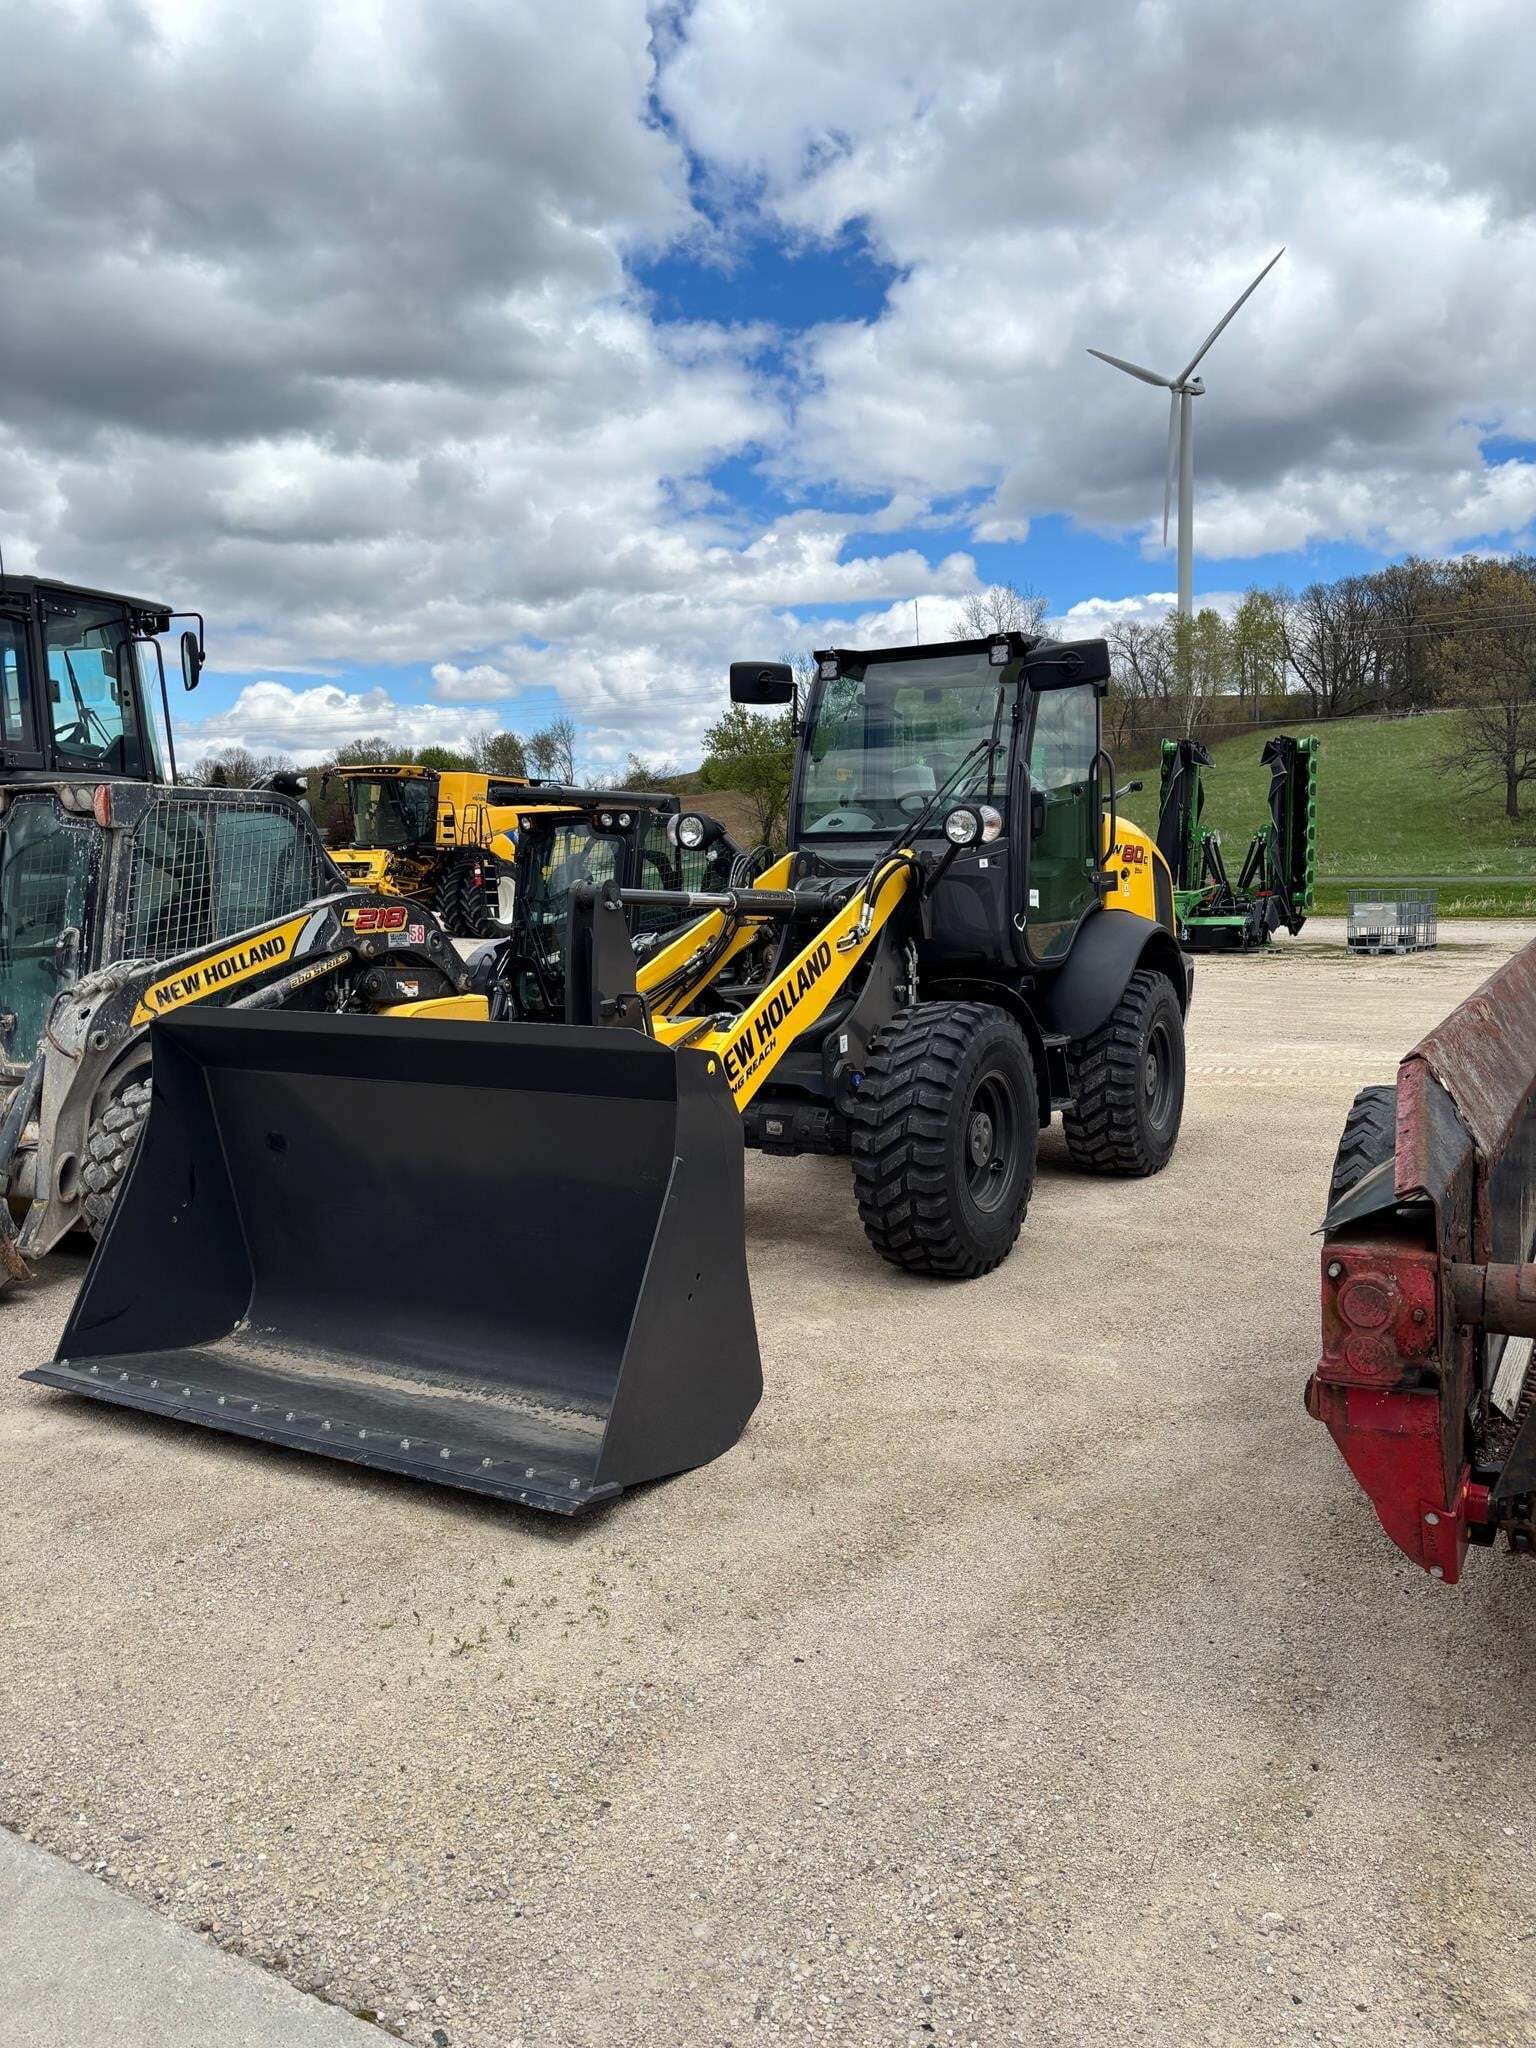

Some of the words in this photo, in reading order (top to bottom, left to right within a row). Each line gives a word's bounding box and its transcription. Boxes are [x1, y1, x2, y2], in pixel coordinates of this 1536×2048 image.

[342, 907, 408, 933] L218
[410, 926, 424, 942] 58
[154, 972, 200, 1007] NEW
[203, 935, 286, 986] HOLLAND
[290, 972, 312, 989] 200
[314, 952, 350, 976] SERIES
[723, 1027, 755, 1082] EW
[755, 941, 832, 1046] HOLLAND
[745, 1037, 776, 1079] REACH
